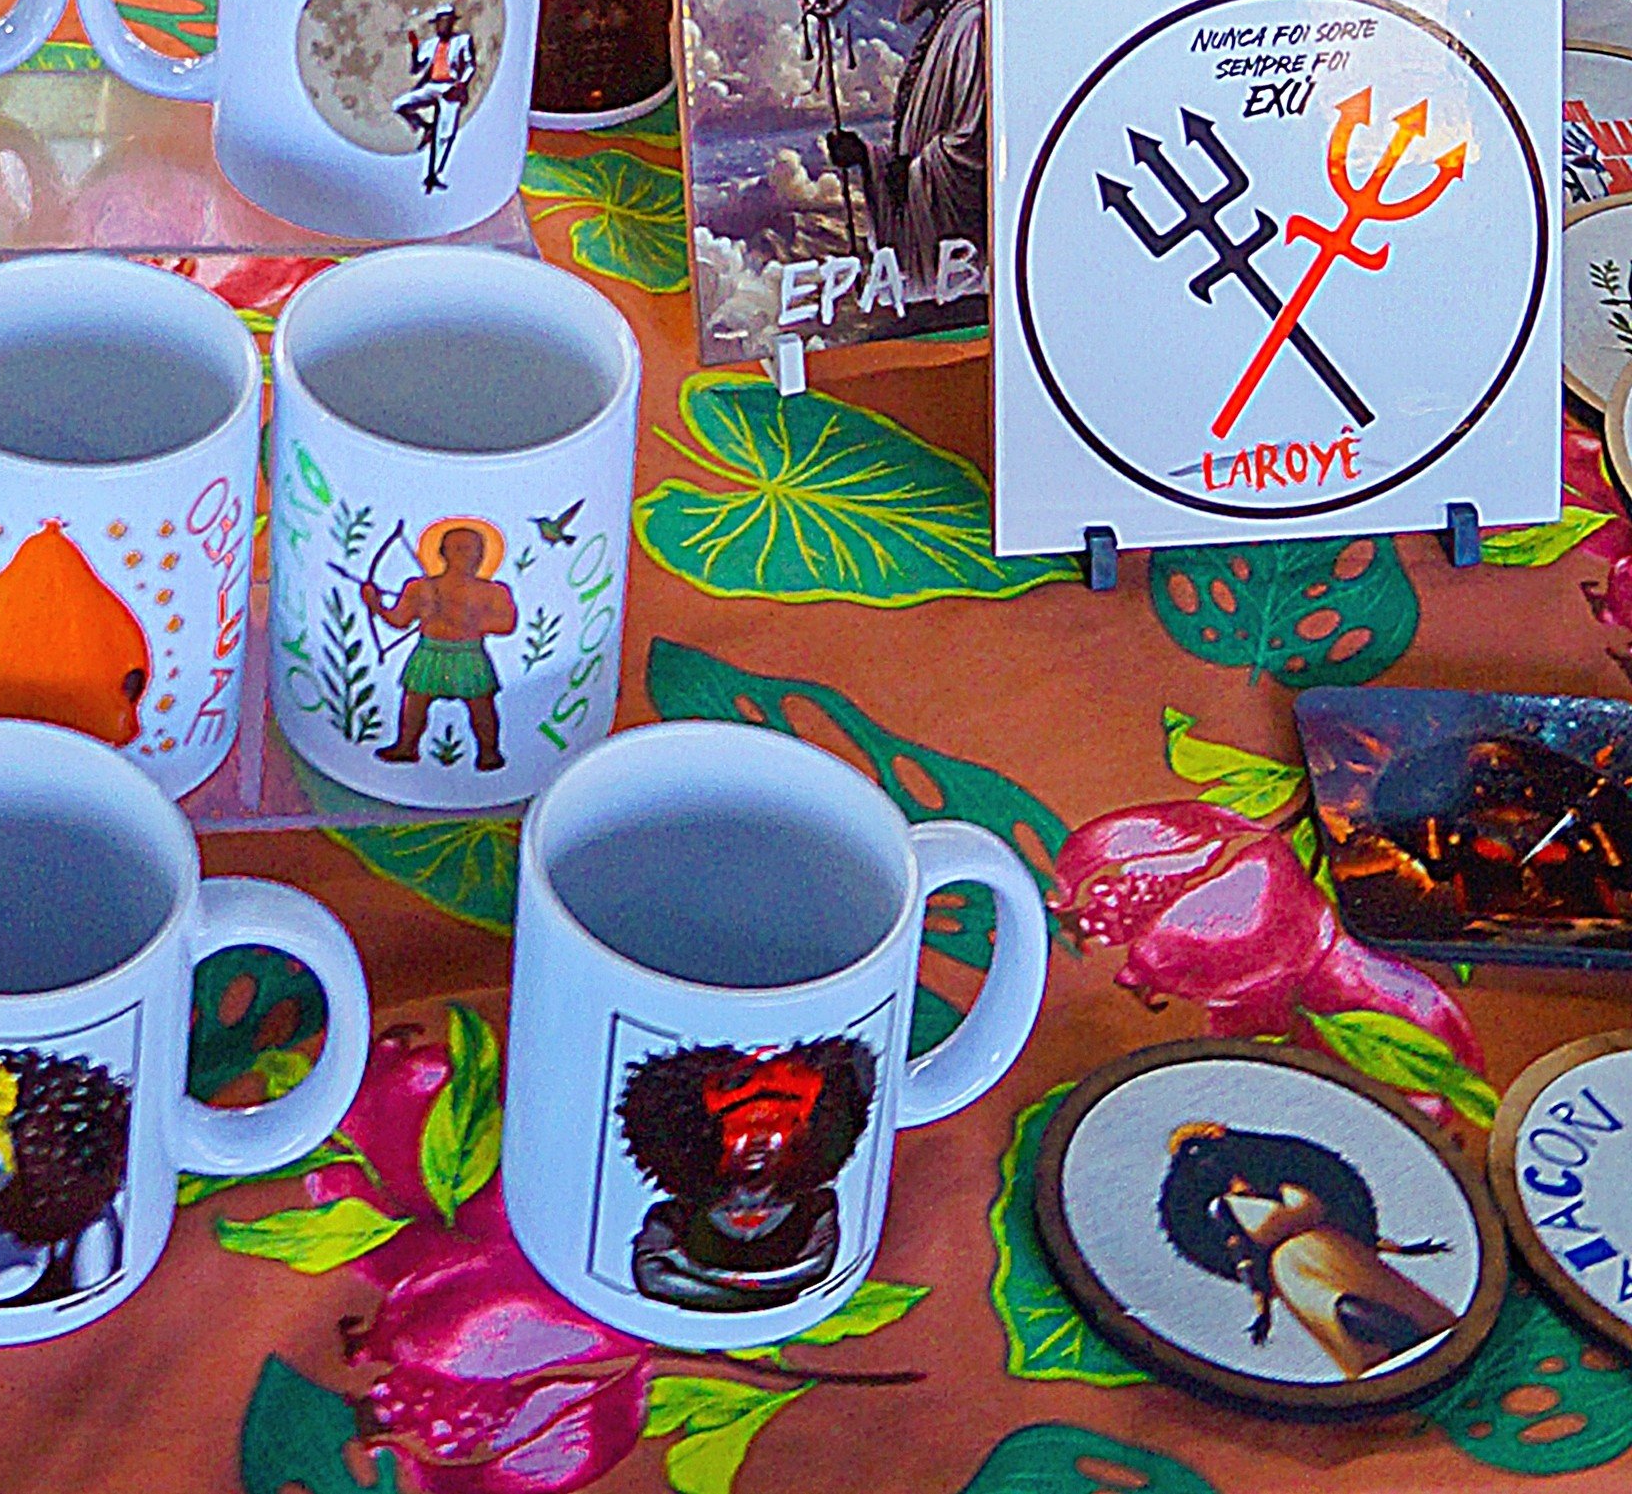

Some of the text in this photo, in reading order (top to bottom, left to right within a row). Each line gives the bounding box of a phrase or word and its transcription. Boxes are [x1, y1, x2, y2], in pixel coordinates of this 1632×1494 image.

[1190, 18, 1379, 52] NUNCA FOI SORTE
[1215, 50, 1350, 80] SEMPRE FOI
[1243, 74, 1316, 119] EXÚ
[778, 238, 991, 327] EPA B
